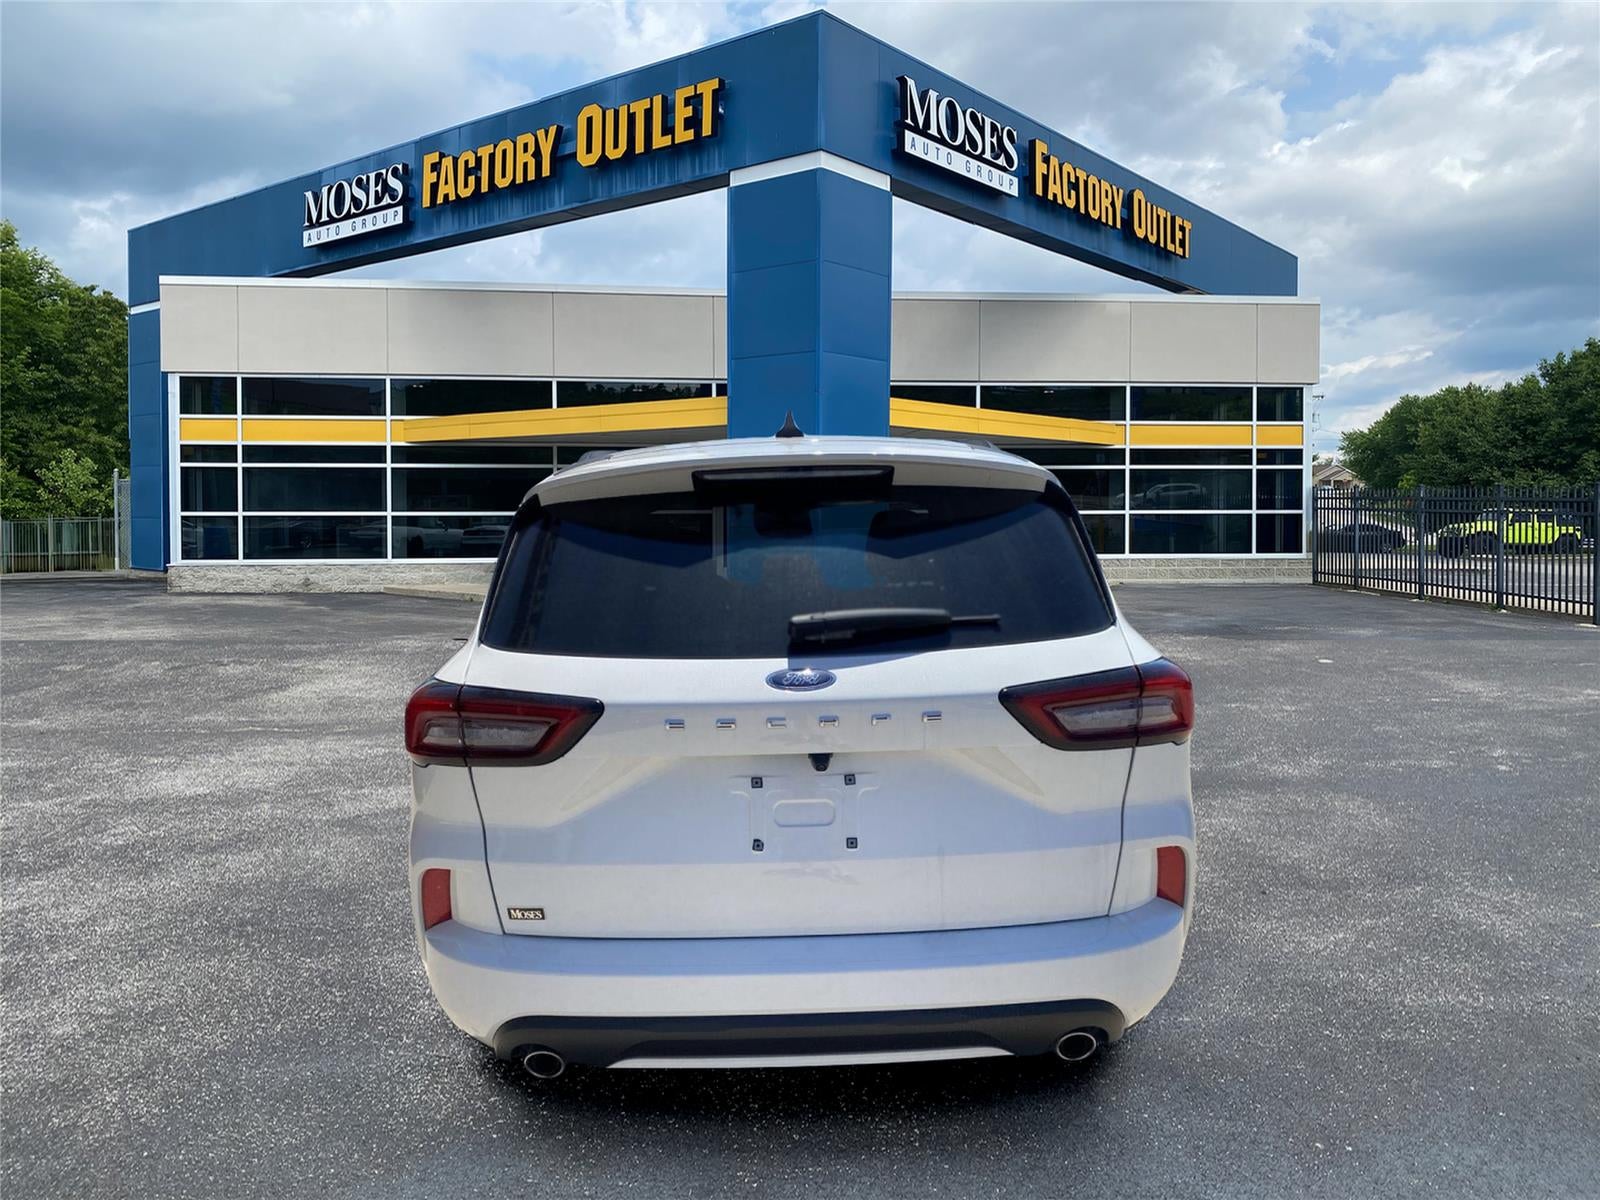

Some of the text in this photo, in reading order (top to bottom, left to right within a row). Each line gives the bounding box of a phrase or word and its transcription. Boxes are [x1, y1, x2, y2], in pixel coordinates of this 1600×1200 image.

[422, 77, 721, 208] FACTORY OUTLET
[904, 75, 1018, 172] MOSES
[910, 137, 1015, 191] AUTO GROUP
[303, 163, 405, 227] MOSES
[1035, 138, 1192, 259] FACTORY OUTLET
[307, 210, 400, 243] AUTO GROUP
[782, 671, 822, 685] Ford
[664, 710, 943, 730] ESCAPE
[510, 909, 542, 920] MOSES
